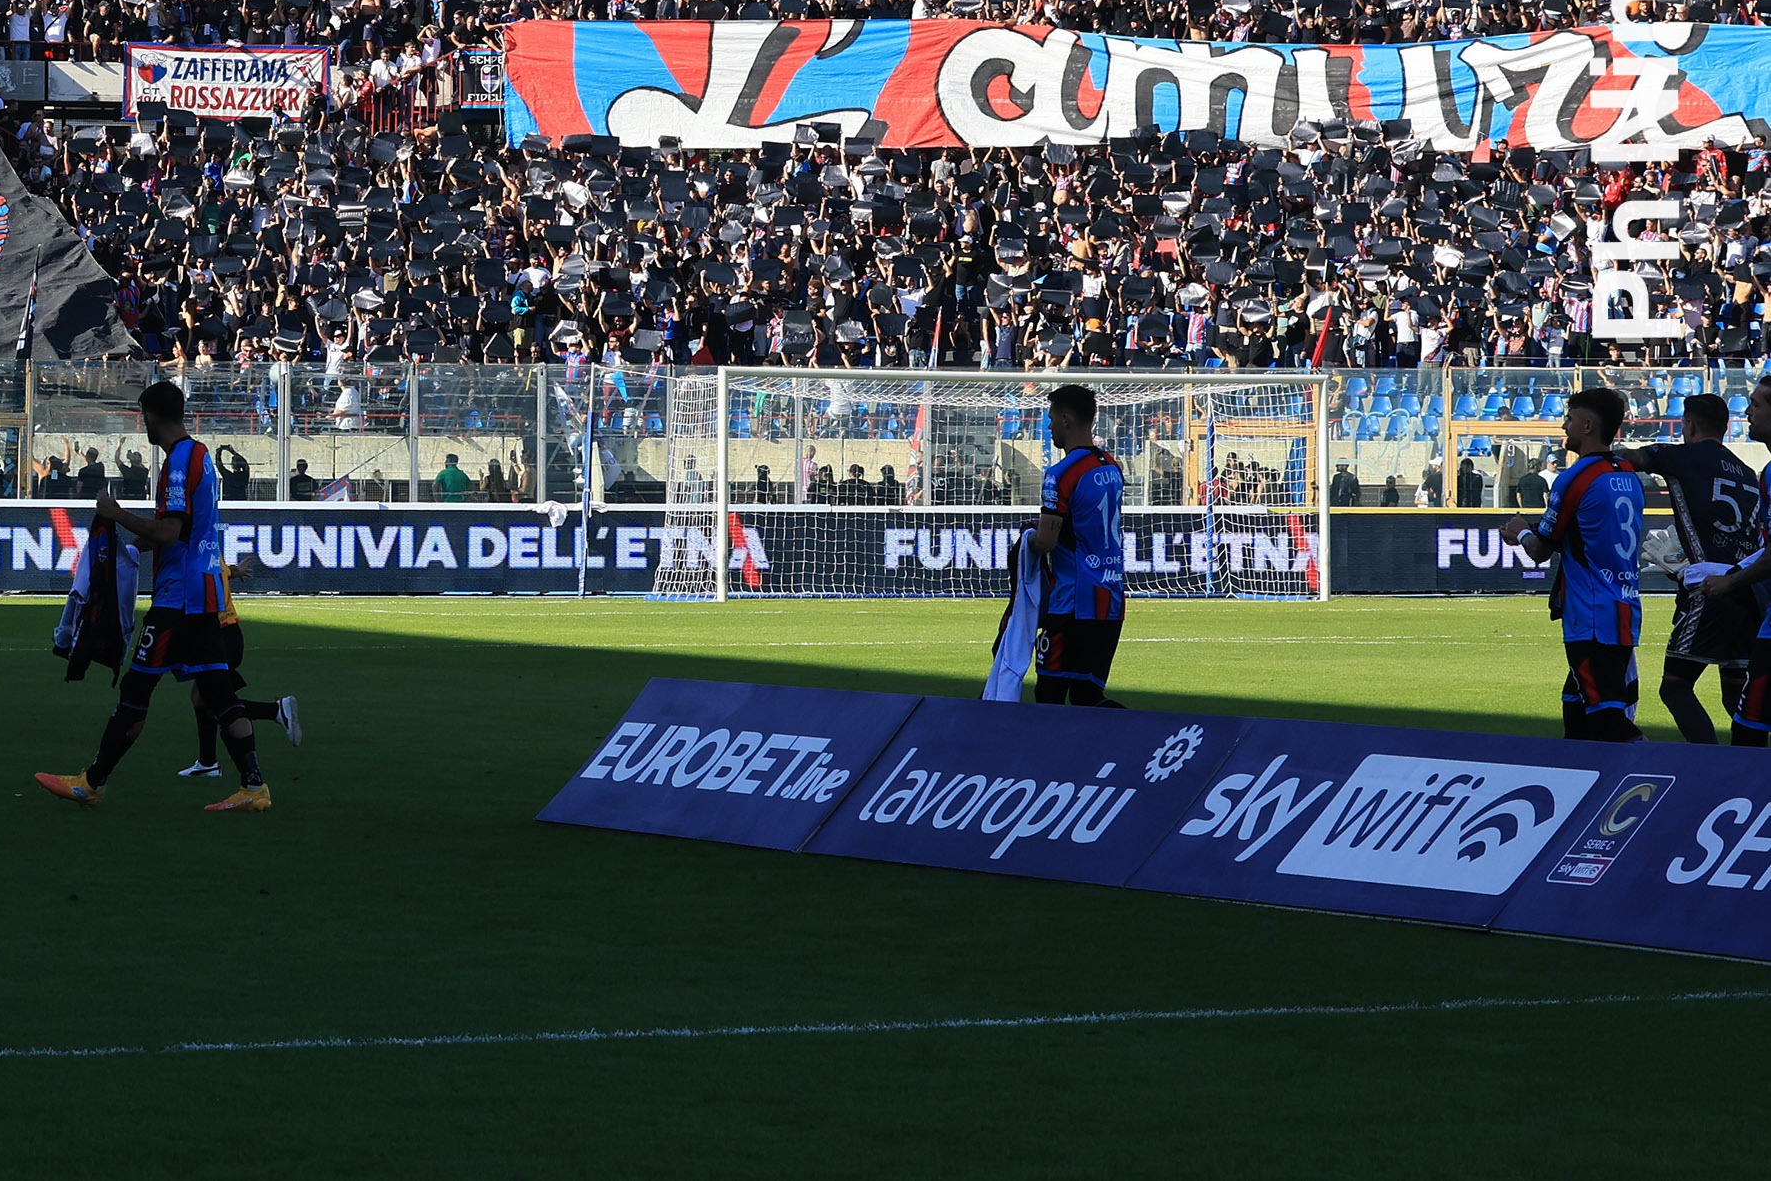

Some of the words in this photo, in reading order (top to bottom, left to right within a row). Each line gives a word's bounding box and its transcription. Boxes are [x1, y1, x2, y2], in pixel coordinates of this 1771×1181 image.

[171, 56, 291, 86] ZAFFERANA
[170, 85, 306, 111] ROSSAZZURR
[467, 93, 504, 102] FIDEL
[1721, 460, 1744, 477] DINI
[1610, 477, 1633, 492] CELLI
[1614, 496, 1637, 562] 3
[226, 524, 458, 570] FUNIVIA
[467, 524, 770, 572] DELL'ETNA
[1121, 530, 1320, 574] LL'ETNA
[1179, 754, 1334, 862] sky
[1583, 839, 1606, 850] SERIE
[1605, 840, 1616, 851] C
[1666, 797, 1771, 891] SE
[1557, 862, 1576, 876] sky
